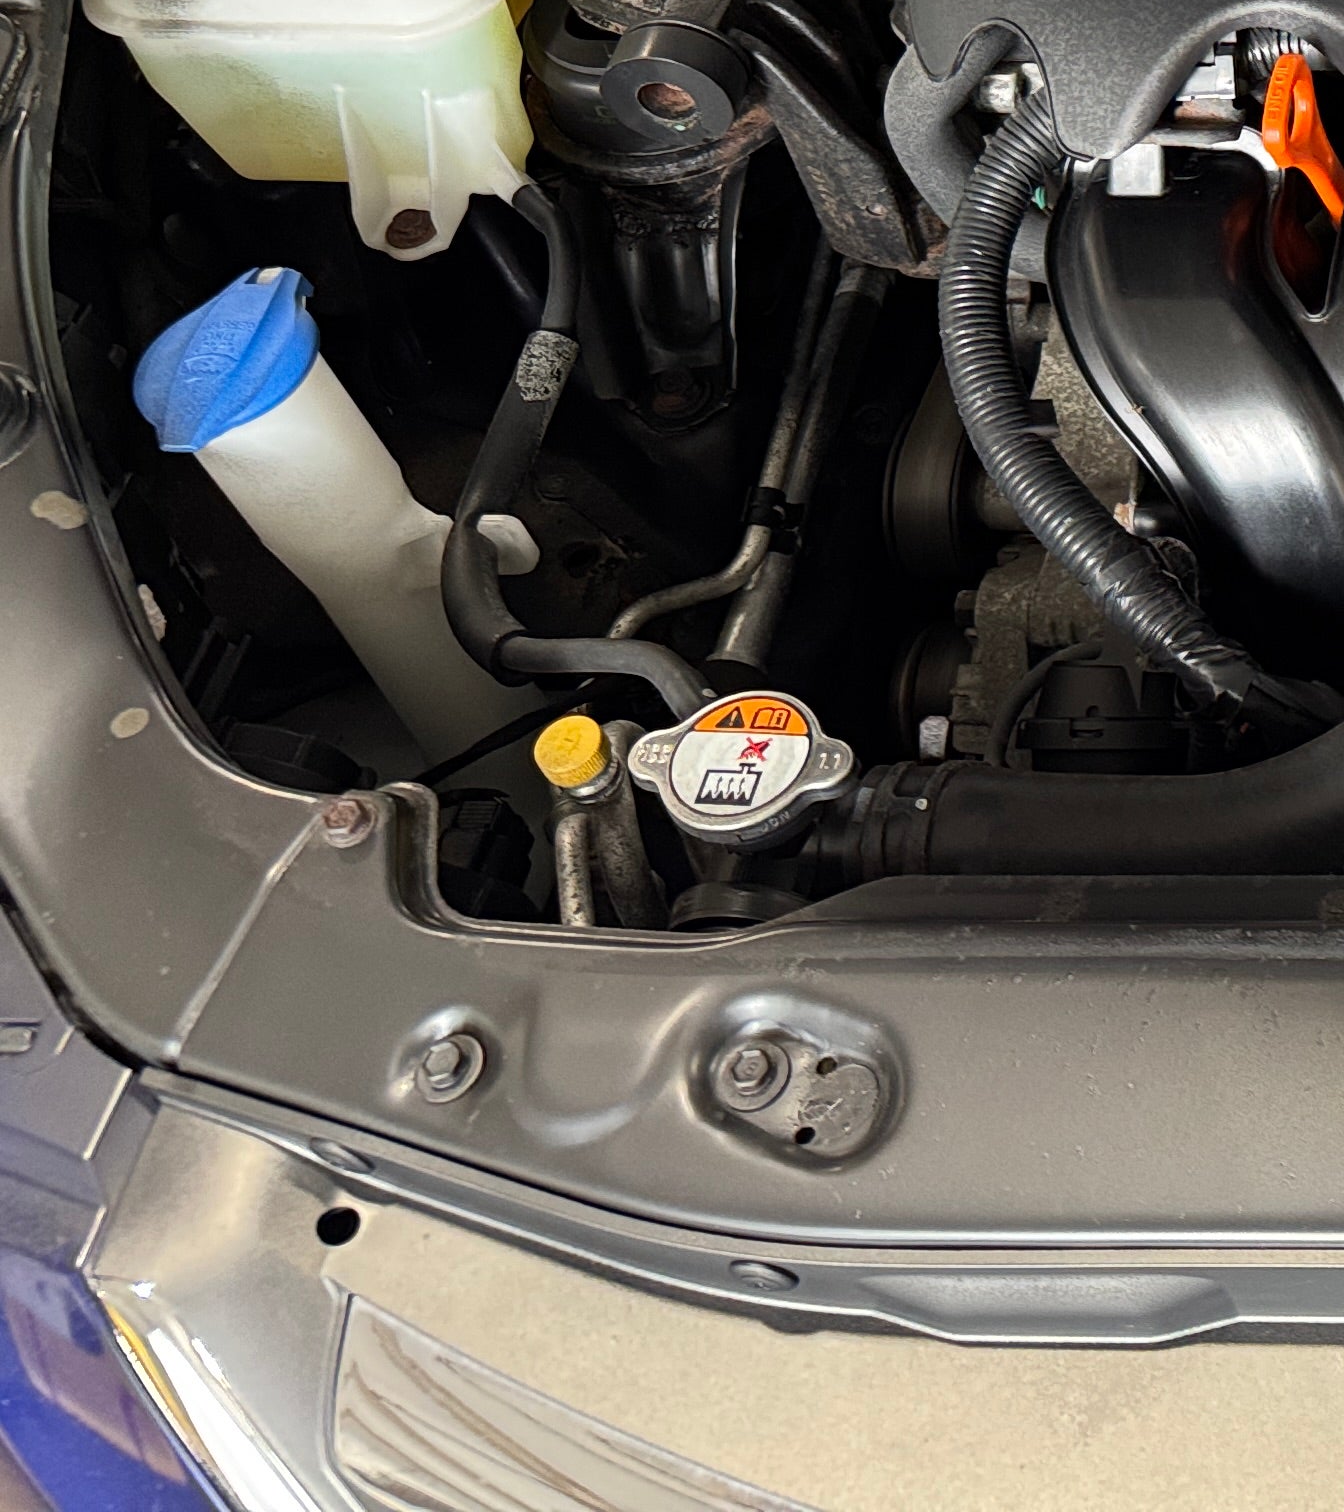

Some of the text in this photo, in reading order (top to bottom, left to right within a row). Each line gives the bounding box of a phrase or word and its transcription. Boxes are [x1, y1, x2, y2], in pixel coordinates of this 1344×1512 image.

[1267, 65, 1288, 121] ENG OIL
[818, 751, 842, 770] 1.1
